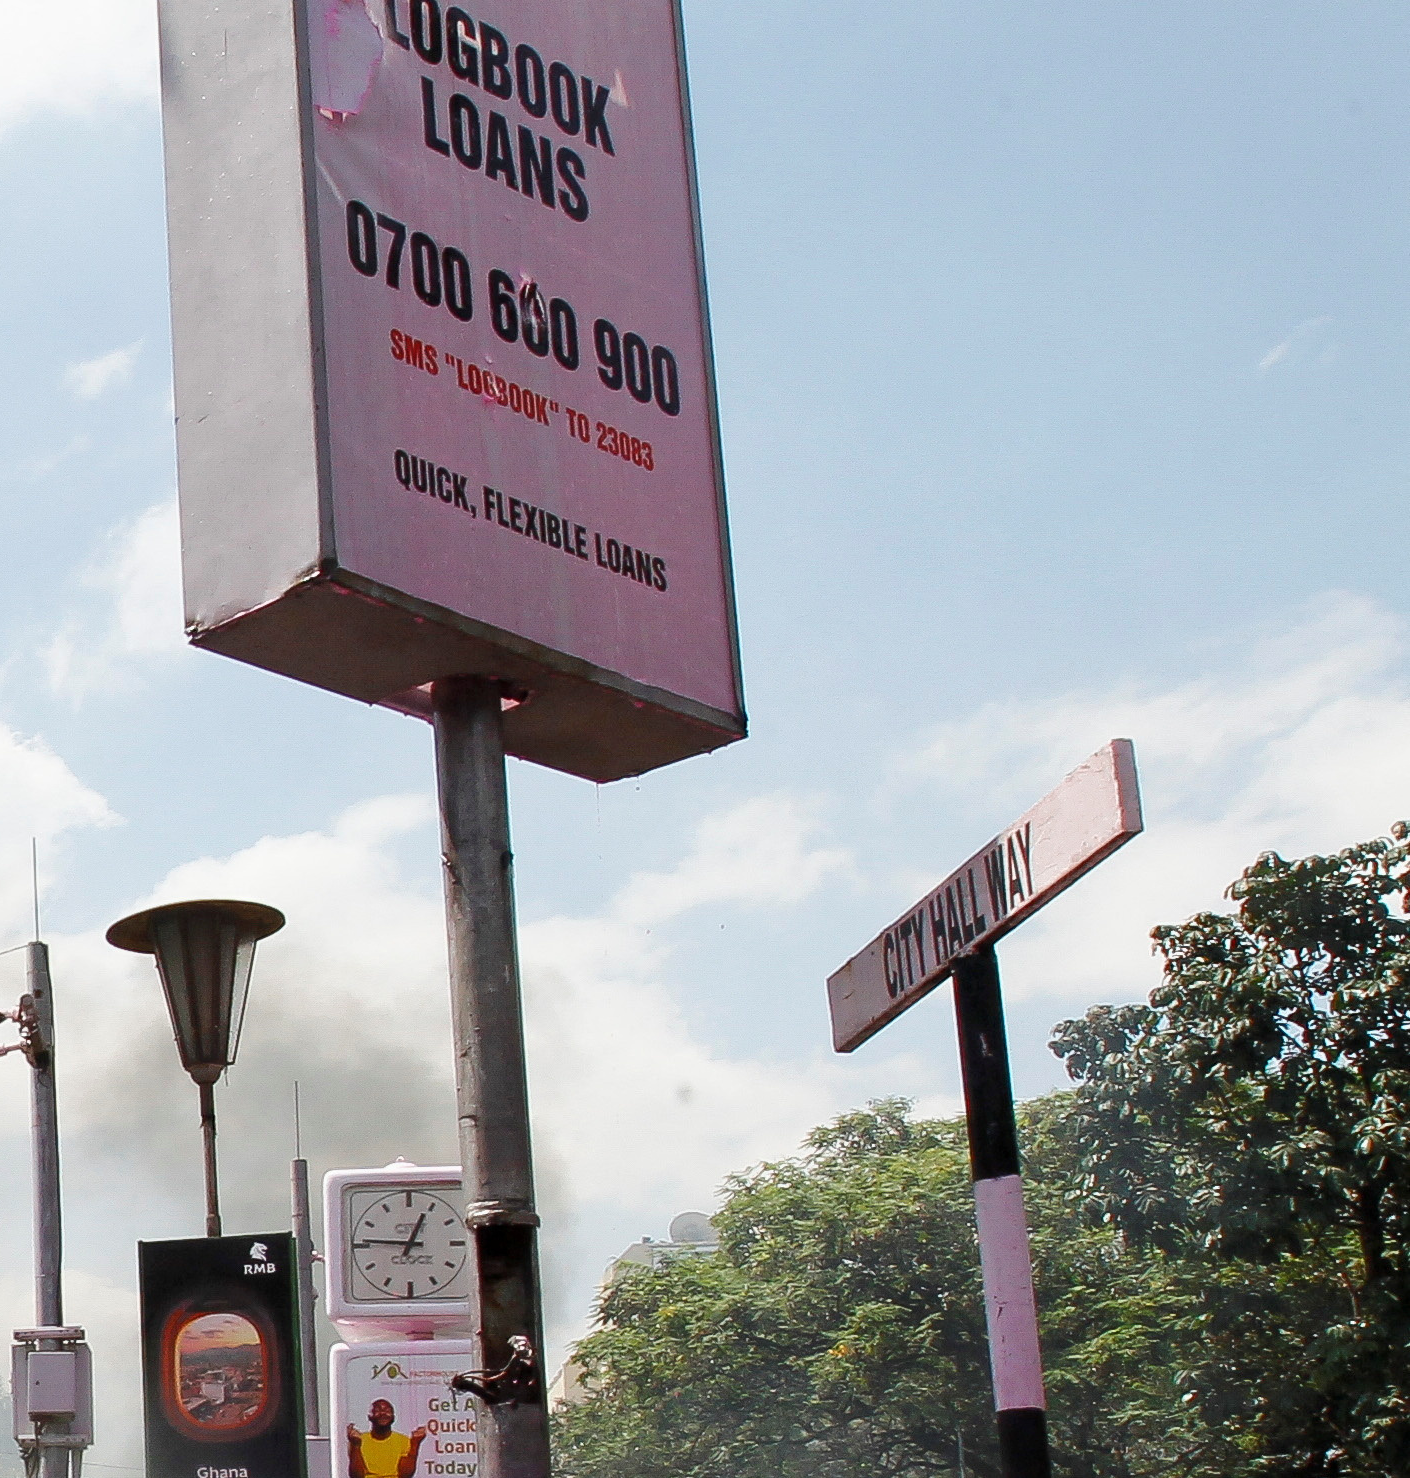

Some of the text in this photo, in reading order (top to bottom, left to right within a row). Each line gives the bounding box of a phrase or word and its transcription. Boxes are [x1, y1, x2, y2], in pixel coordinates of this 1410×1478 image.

[383, 0, 616, 158] LOGBOOK
[420, 75, 590, 223] LOANS
[345, 199, 473, 323] 0700
[593, 317, 680, 417] 900
[389, 328, 439, 376] SMS
[565, 406, 591, 444] TO
[595, 421, 655, 472] 23083
[394, 448, 668, 593] QUICK, FLEXIBLE LOANS
[881, 821, 1034, 1000] CITY HALL WAY
[243, 1262, 276, 1275] RMB
[424, 1460, 478, 1478] Today
[427, 1418, 477, 1435] Quick
[428, 1398, 475, 1412] Get A
[435, 1440, 477, 1454] Loan
